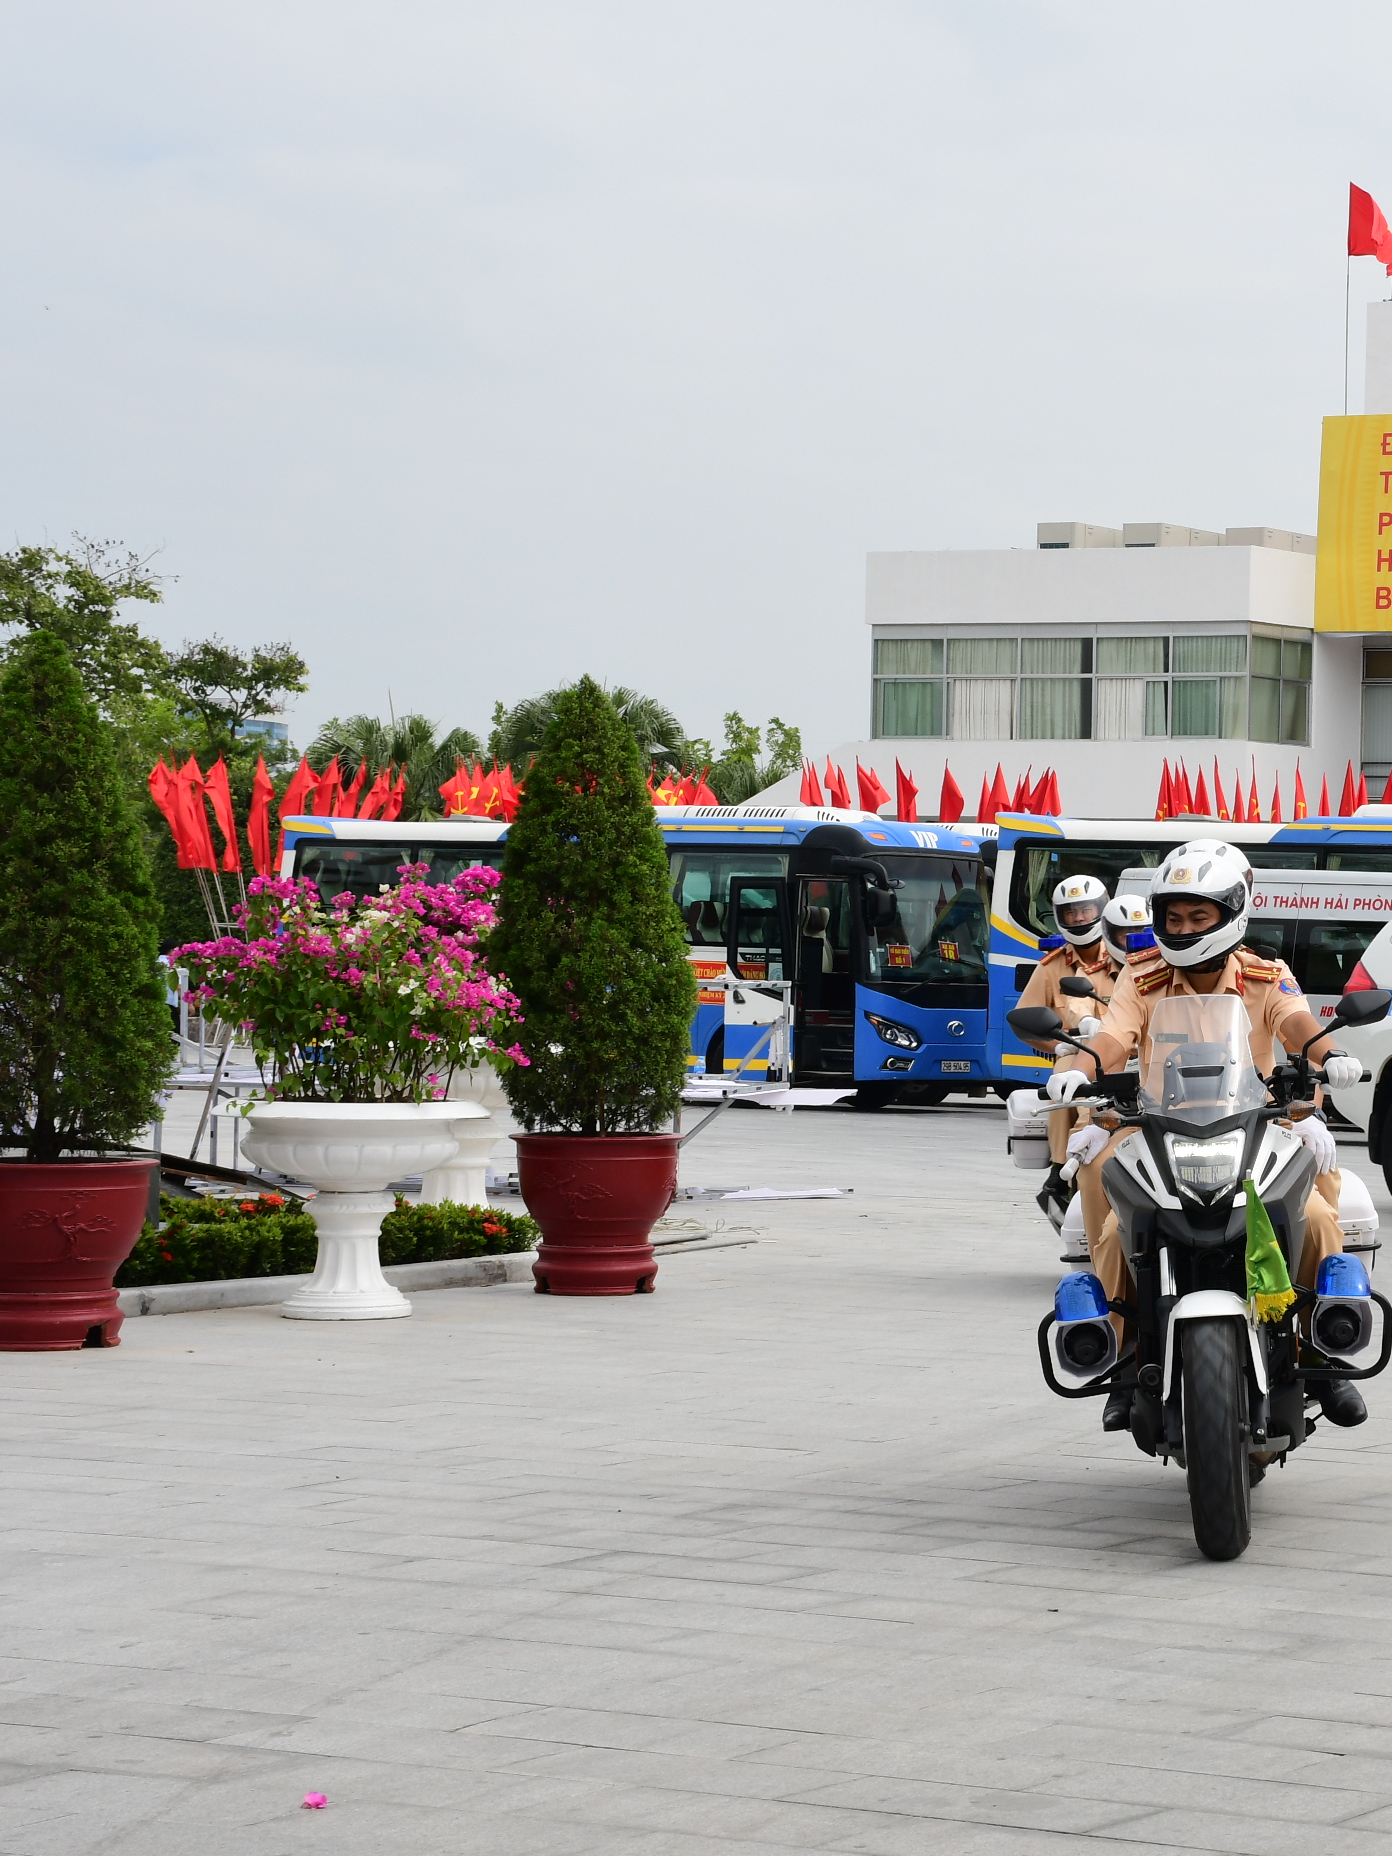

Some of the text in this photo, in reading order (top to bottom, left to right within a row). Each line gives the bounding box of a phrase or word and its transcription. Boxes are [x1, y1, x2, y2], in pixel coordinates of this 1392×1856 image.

[909, 830, 939, 849] VIP
[1252, 891, 1268, 911] ỘI
[1273, 891, 1321, 910] THÀNH
[1325, 893, 1350, 911] HẢI
